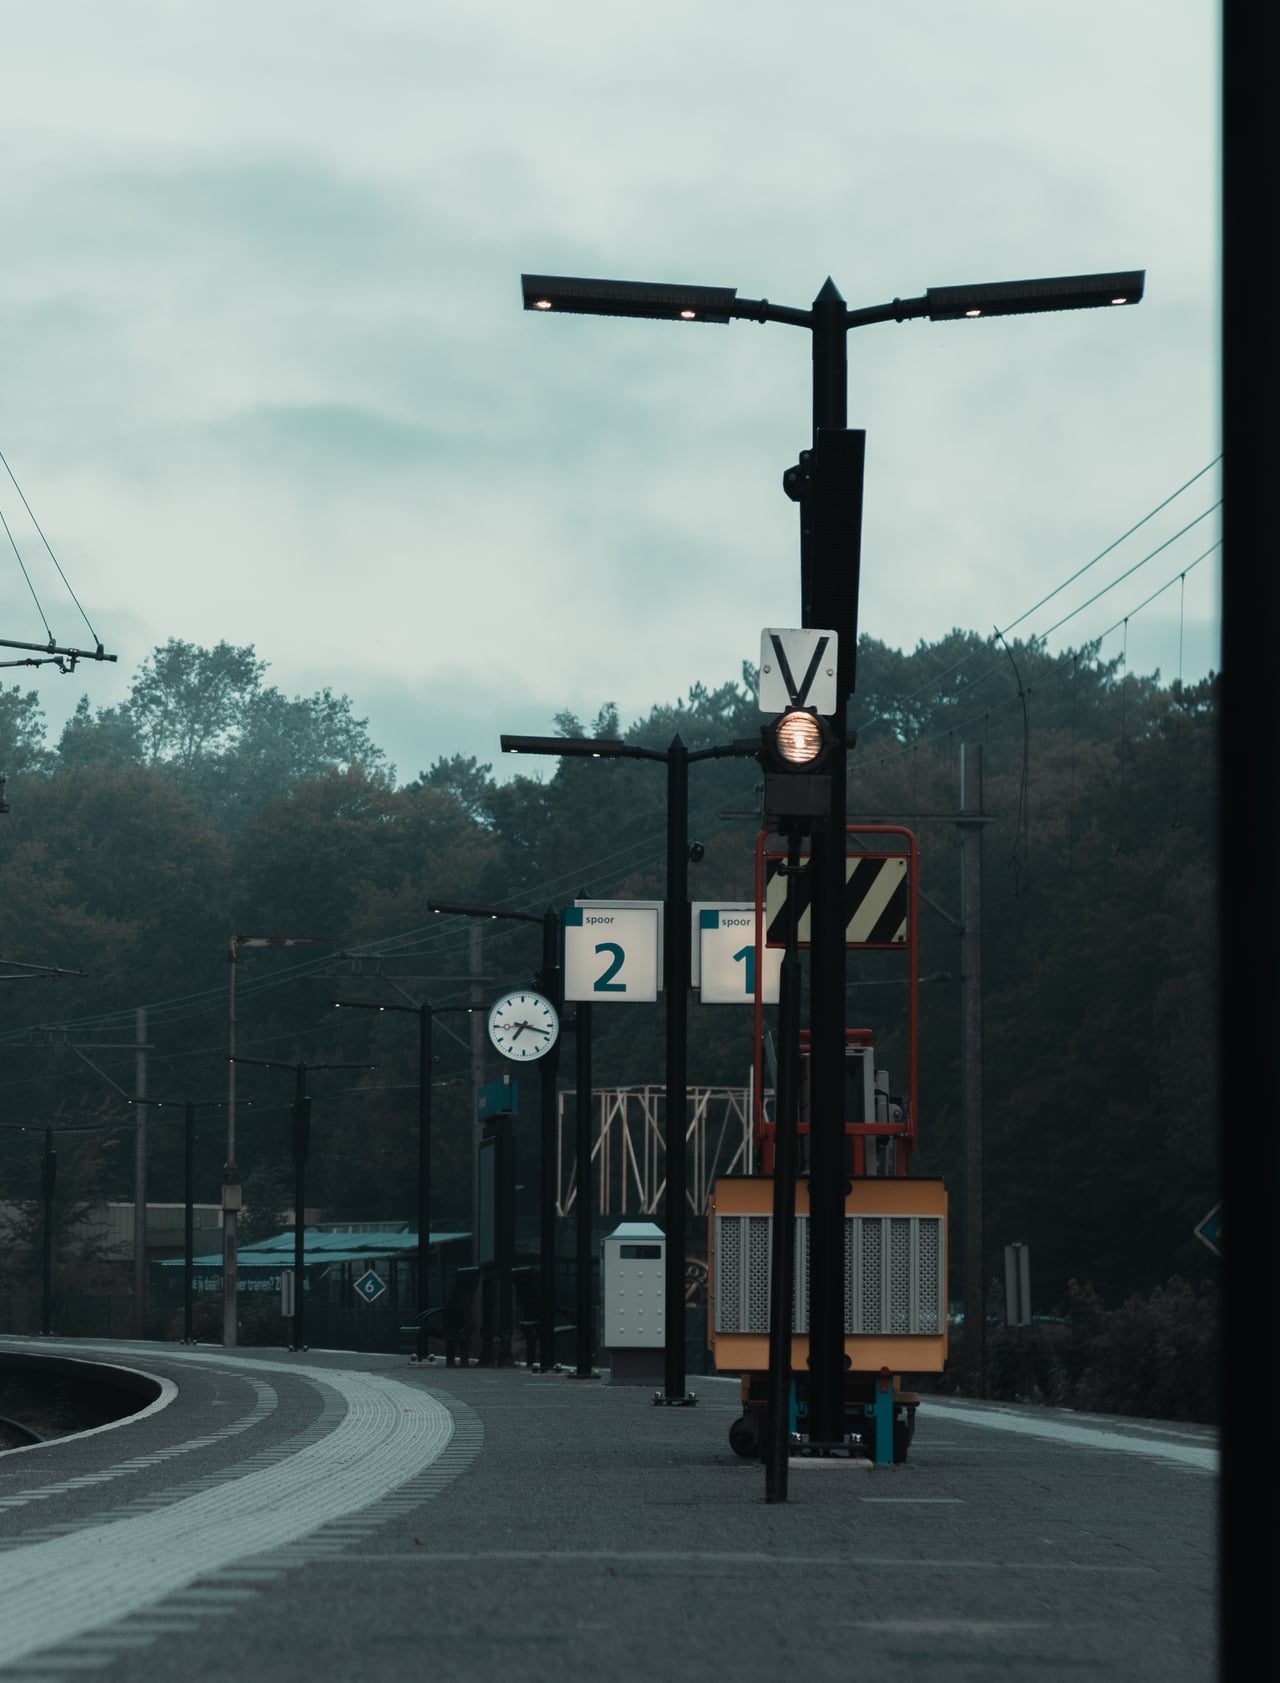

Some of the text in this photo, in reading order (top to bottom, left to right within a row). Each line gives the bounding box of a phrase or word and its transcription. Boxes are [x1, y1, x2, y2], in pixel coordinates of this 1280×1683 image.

[769, 634, 830, 707] V
[585, 916, 615, 926] spoor
[721, 918, 751, 928] spoor
[593, 942, 627, 992] 2
[733, 945, 756, 994] 1
[365, 1279, 375, 1293] 6
